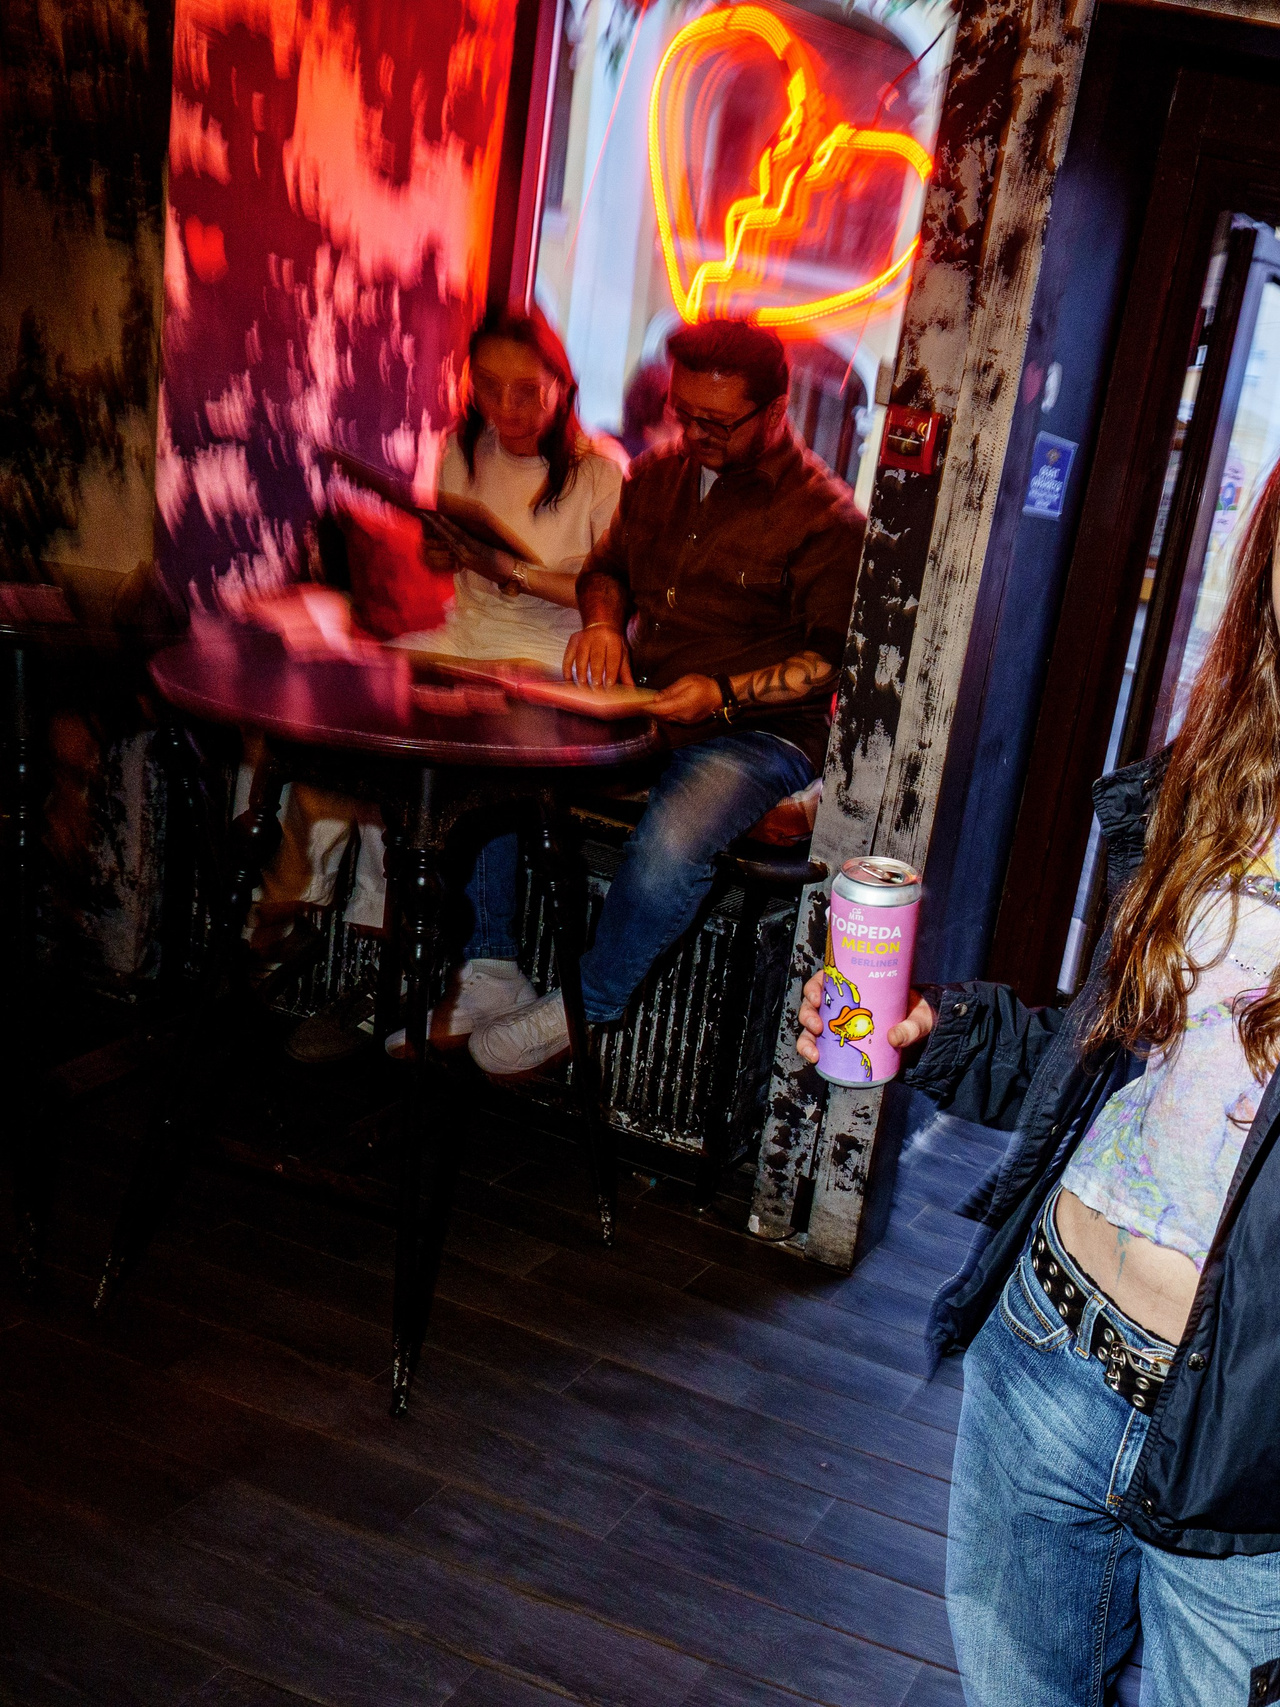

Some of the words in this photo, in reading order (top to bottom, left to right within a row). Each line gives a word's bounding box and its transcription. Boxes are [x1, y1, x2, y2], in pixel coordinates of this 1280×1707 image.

[831, 912, 902, 940] TORPEDA
[841, 936, 900, 955] MELON
[851, 957, 898, 967] BERLINER
